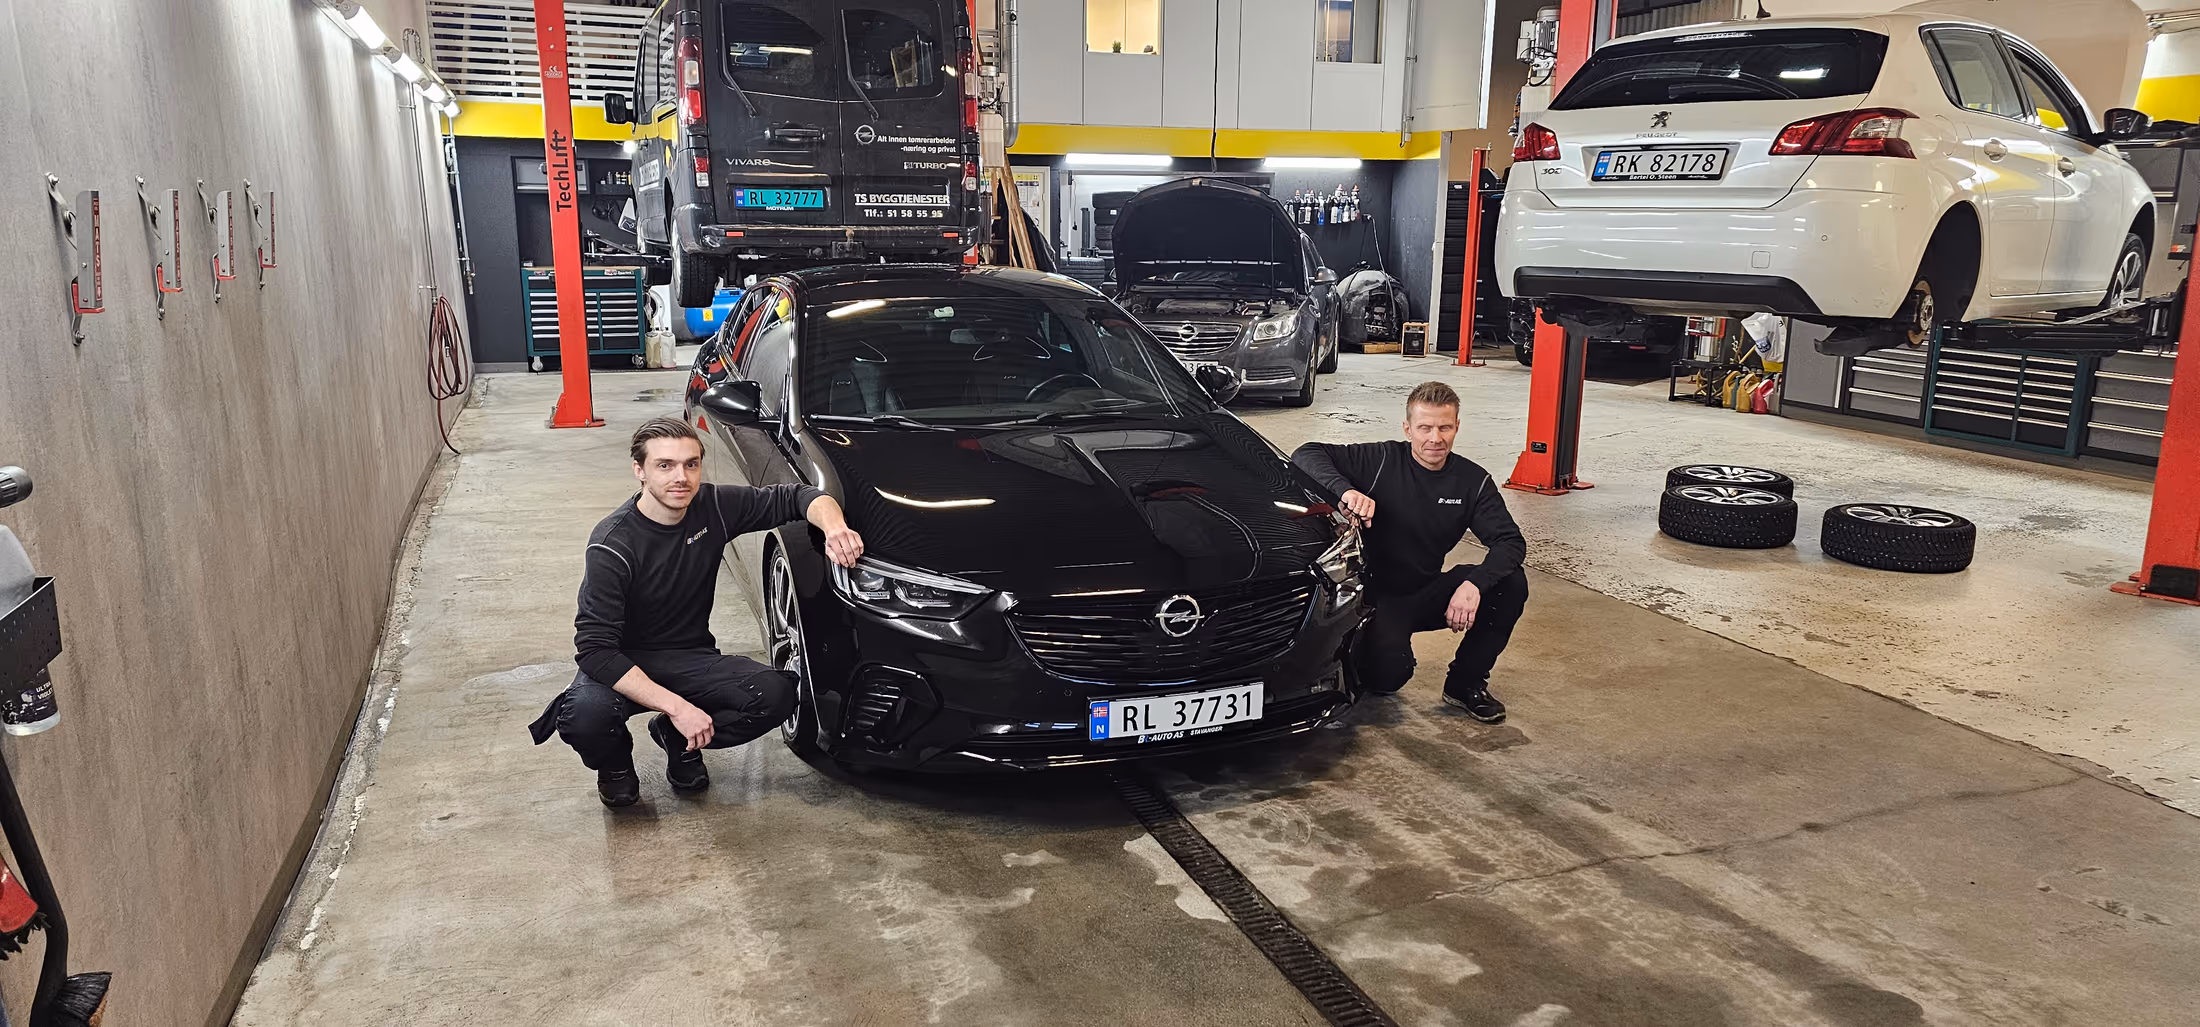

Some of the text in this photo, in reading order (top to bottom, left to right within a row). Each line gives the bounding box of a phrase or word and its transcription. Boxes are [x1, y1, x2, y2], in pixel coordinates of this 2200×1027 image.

[888, 135, 907, 143] innen
[725, 158, 771, 166] VIVARO
[1613, 155, 1643, 173] RK
[1650, 153, 1717, 173] 82178
[550, 132, 571, 212] TechLift
[750, 191, 767, 205] RL
[775, 191, 818, 206] 32777
[855, 193, 950, 204] TS BYGGTJENESTER
[887, 209, 897, 217] 51
[901, 209, 912, 217] 58
[916, 209, 927, 218] 55
[931, 209, 943, 218] 95
[36, 681, 51, 693] ULTRA
[1096, 691, 1252, 734] N RL 37731
[1173, 731, 1184, 739] AS
